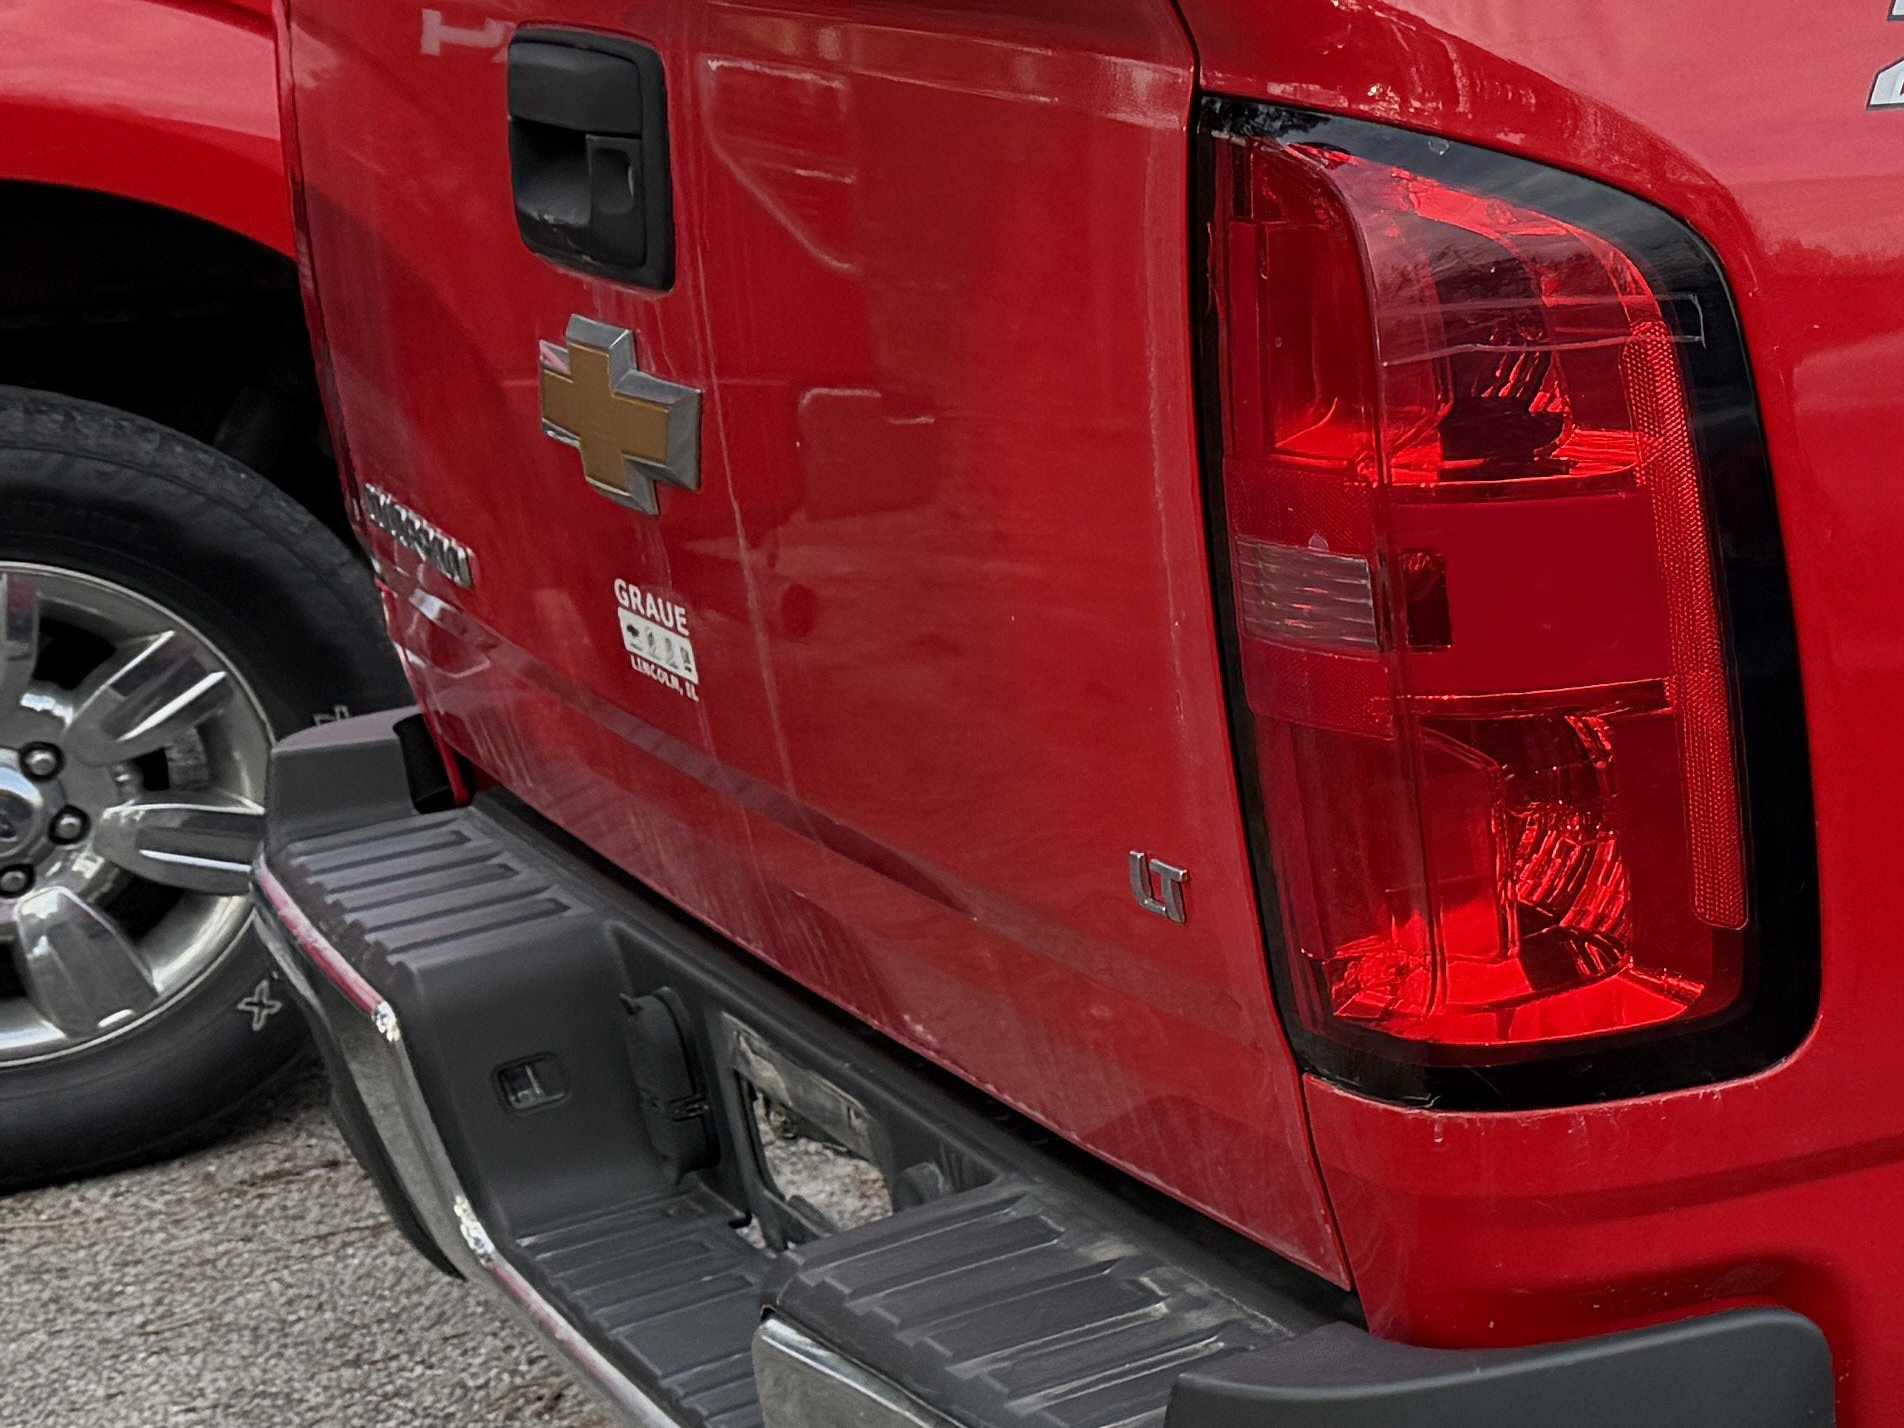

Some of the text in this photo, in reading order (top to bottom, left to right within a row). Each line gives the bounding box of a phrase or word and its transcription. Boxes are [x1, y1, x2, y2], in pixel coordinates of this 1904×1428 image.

[614, 578, 690, 636] GRAUE
[630, 654, 684, 696] LINCOLN,
[1129, 850, 1188, 923] LT
